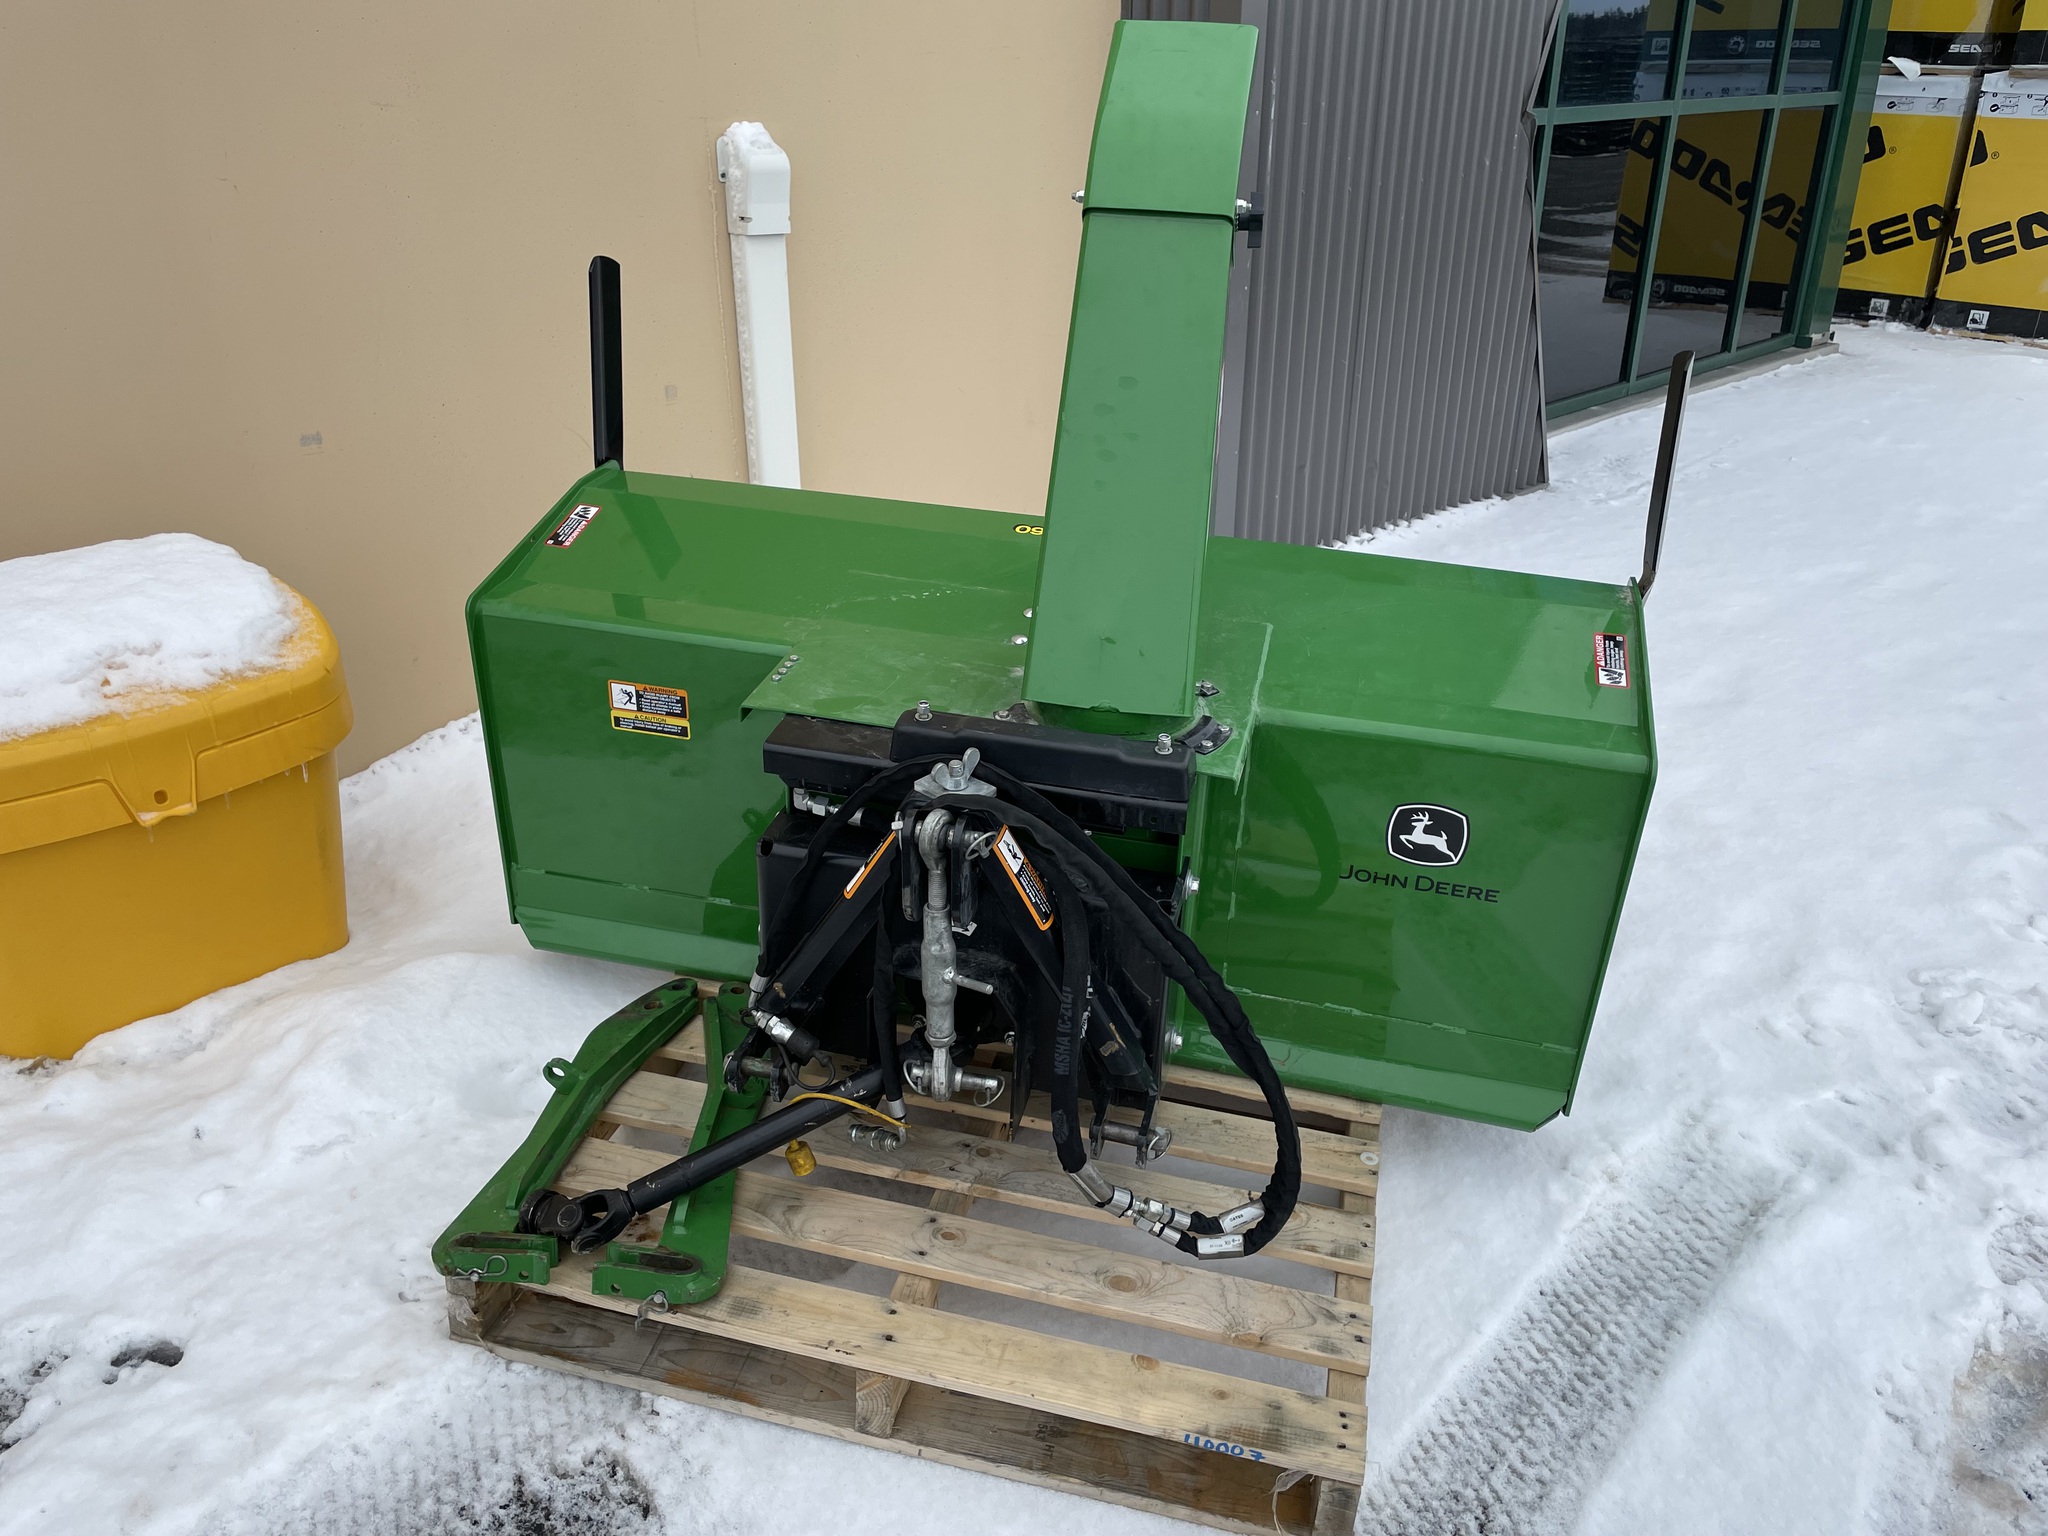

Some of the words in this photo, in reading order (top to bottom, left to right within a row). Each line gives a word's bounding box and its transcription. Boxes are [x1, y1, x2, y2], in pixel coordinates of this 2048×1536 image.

[1595, 635, 1605, 661] DANGER
[640, 715, 667, 723] CAUTION
[1339, 865, 1408, 888] JOHN
[1414, 875, 1500, 903] DEERE
[1054, 1036, 1072, 1075] MSHA
